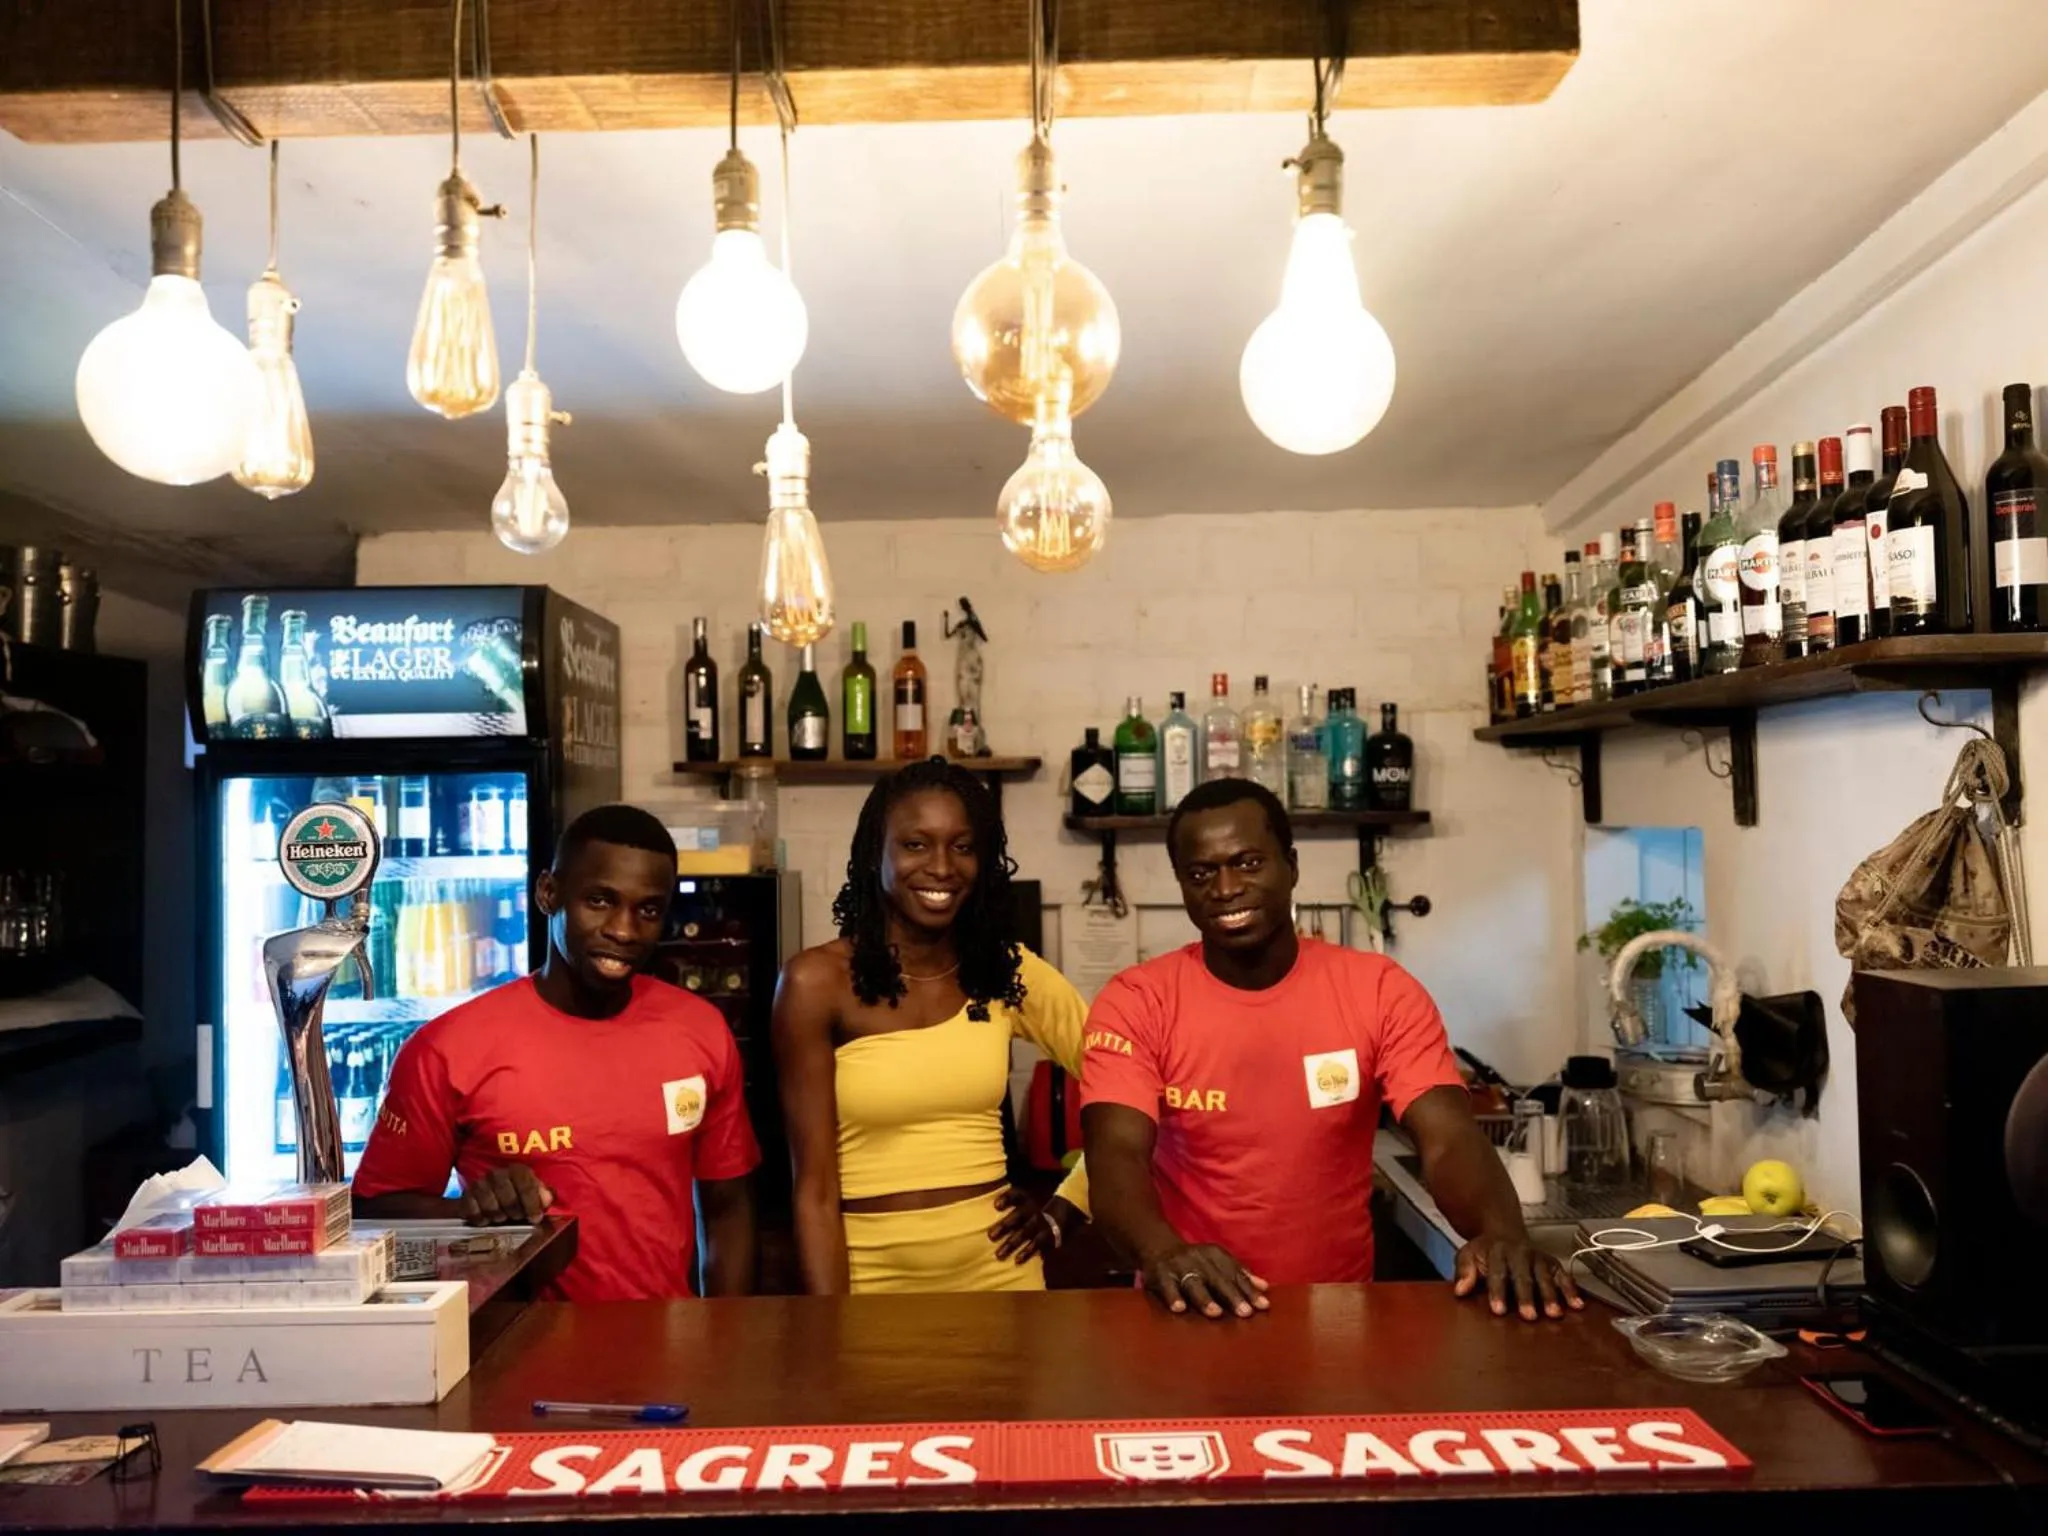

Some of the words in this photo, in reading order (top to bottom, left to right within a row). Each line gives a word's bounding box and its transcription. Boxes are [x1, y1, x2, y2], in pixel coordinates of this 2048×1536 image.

[329, 614, 455, 645] Beaufort
[351, 647, 454, 672] LAGER
[289, 843, 363, 859] Heineken
[1165, 1086, 1227, 1112] BAR
[496, 1126, 574, 1155] BAR
[202, 1211, 247, 1227] Marlboro
[263, 1208, 308, 1226] Marlboro
[122, 1237, 167, 1255] Marlboro
[202, 1235, 246, 1252] Marlboro
[262, 1233, 307, 1251] Marlboro
[1252, 1420, 1728, 1479] SAGRES
[507, 1435, 978, 1497] SAGRES
